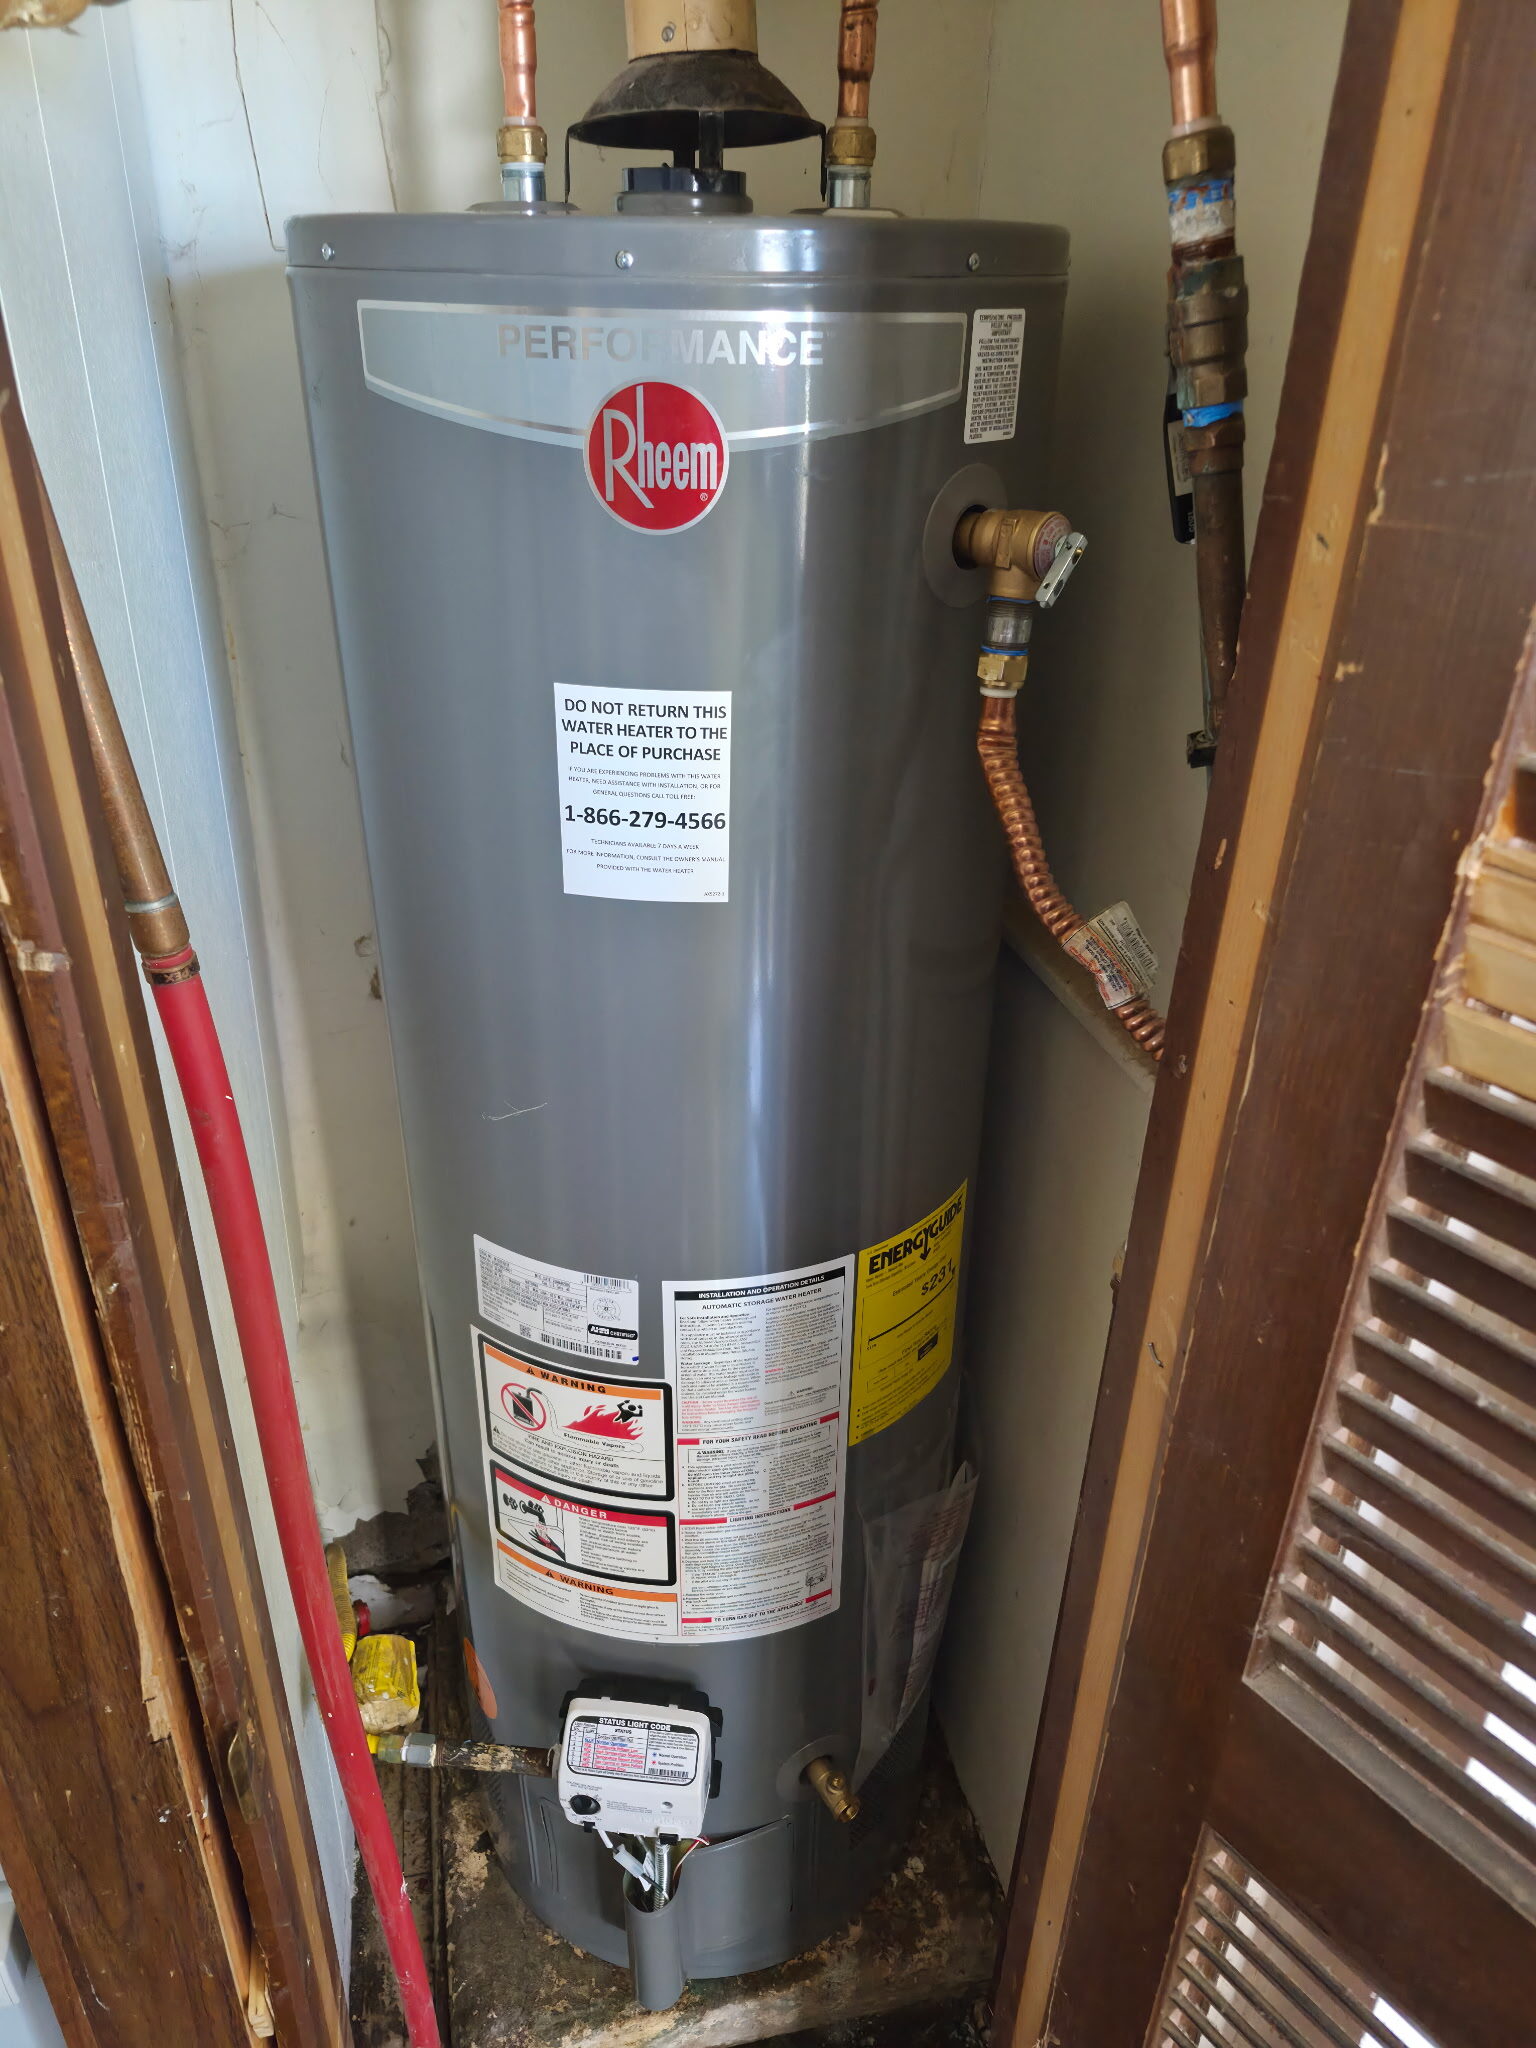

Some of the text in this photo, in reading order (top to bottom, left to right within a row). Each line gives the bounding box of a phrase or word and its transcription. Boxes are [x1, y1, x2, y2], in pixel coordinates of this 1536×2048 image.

[497, 324, 824, 366] PERFORMANCE
[602, 384, 717, 508] Rheem
[564, 698, 727, 719] DO NOT RETURN THIS
[561, 718, 728, 740] WATER HEATER TO THE
[570, 741, 721, 761] PLACE OF PURCHASE
[565, 804, 726, 830] 1-866-279-4566
[869, 1192, 963, 1275] ENERGYGUIDE
[698, 1275, 825, 1299] INSTALLATION AND OPERATION DETAILS
[702, 1287, 822, 1310] AUTOMATIC STORAGE WATER HEATER
[540, 1370, 607, 1394] WARNING
[563, 1432, 626, 1449] Flammable Vapors
[554, 1498, 608, 1520] DANGER
[559, 1574, 614, 1596] WARNING
[599, 1717, 671, 1731] STATUS LIGHT CODE
